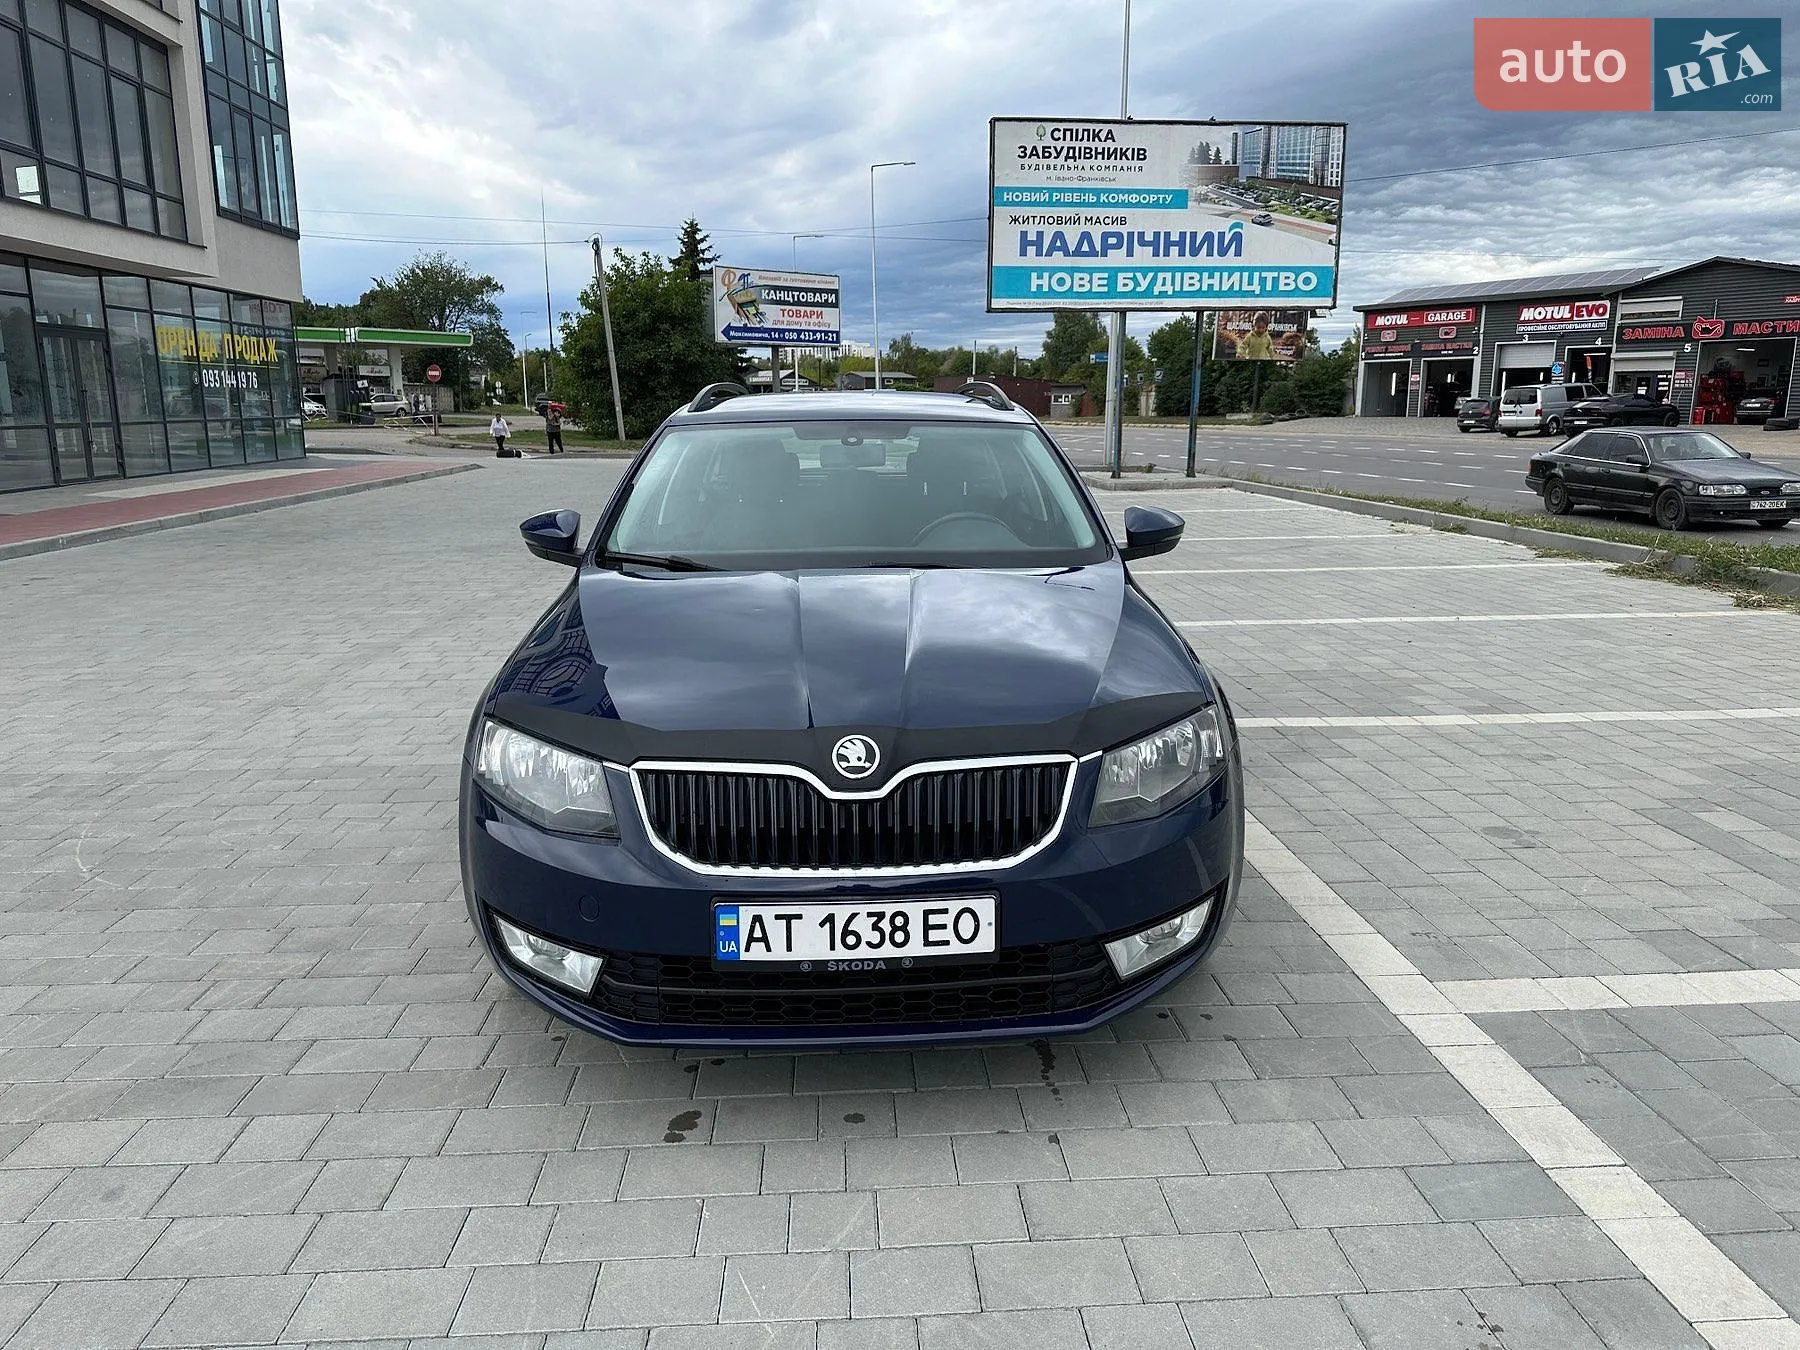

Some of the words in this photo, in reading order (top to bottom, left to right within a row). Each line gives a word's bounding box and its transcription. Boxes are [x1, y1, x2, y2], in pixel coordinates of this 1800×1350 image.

[1050, 128, 1116, 143] СПІЛКА
[1017, 145, 1148, 162] ЗАБУДІВНИКІВ
[1020, 164, 1086, 172] БУДІВЕЛЬНА
[1089, 165, 1143, 173] КОМПАНІЯ
[1003, 190, 1049, 202] НОВИЙ
[1053, 193, 1097, 203] РІВЕНЬ
[1100, 193, 1173, 204] КОМФОРТУ
[1008, 213, 1080, 226] ЖИТЛОВИЙ
[1085, 216, 1128, 226] МАСИВ
[1019, 221, 1244, 258] НАДРІЧНИЙ
[1030, 271, 1109, 292] НОВЕ
[1117, 271, 1318, 295] БУДІВНИЦТВО
[761, 289, 836, 304] КАНЦТОВАРИ
[780, 308, 824, 319] ТОВАРИ
[1375, 314, 1409, 326] MOTUL
[1427, 311, 1467, 322] GARAGE
[1520, 305, 1572, 321] MOTUL
[1575, 303, 1608, 319] EVO
[784, 332, 798, 340] 050
[800, 332, 837, 341] 433-91-21
[1622, 326, 1685, 340] ЗАМІНА
[1732, 320, 1800, 335] МАСТИ
[157, 326, 219, 362] ОРЕНДА
[223, 333, 279, 365] ПРОДАЖ
[1522, 334, 1529, 343] 3
[1595, 337, 1602, 346] 4
[1472, 346, 1479, 355] 2
[1683, 343, 1692, 353] 5
[202, 369, 220, 388] 093
[221, 369, 237, 388] 144
[237, 371, 247, 388] 19
[247, 371, 258, 389] 76
[719, 940, 738, 953] UA
[744, 914, 803, 953] AT
[818, 911, 911, 951] 1638
[922, 907, 981, 948] EO
